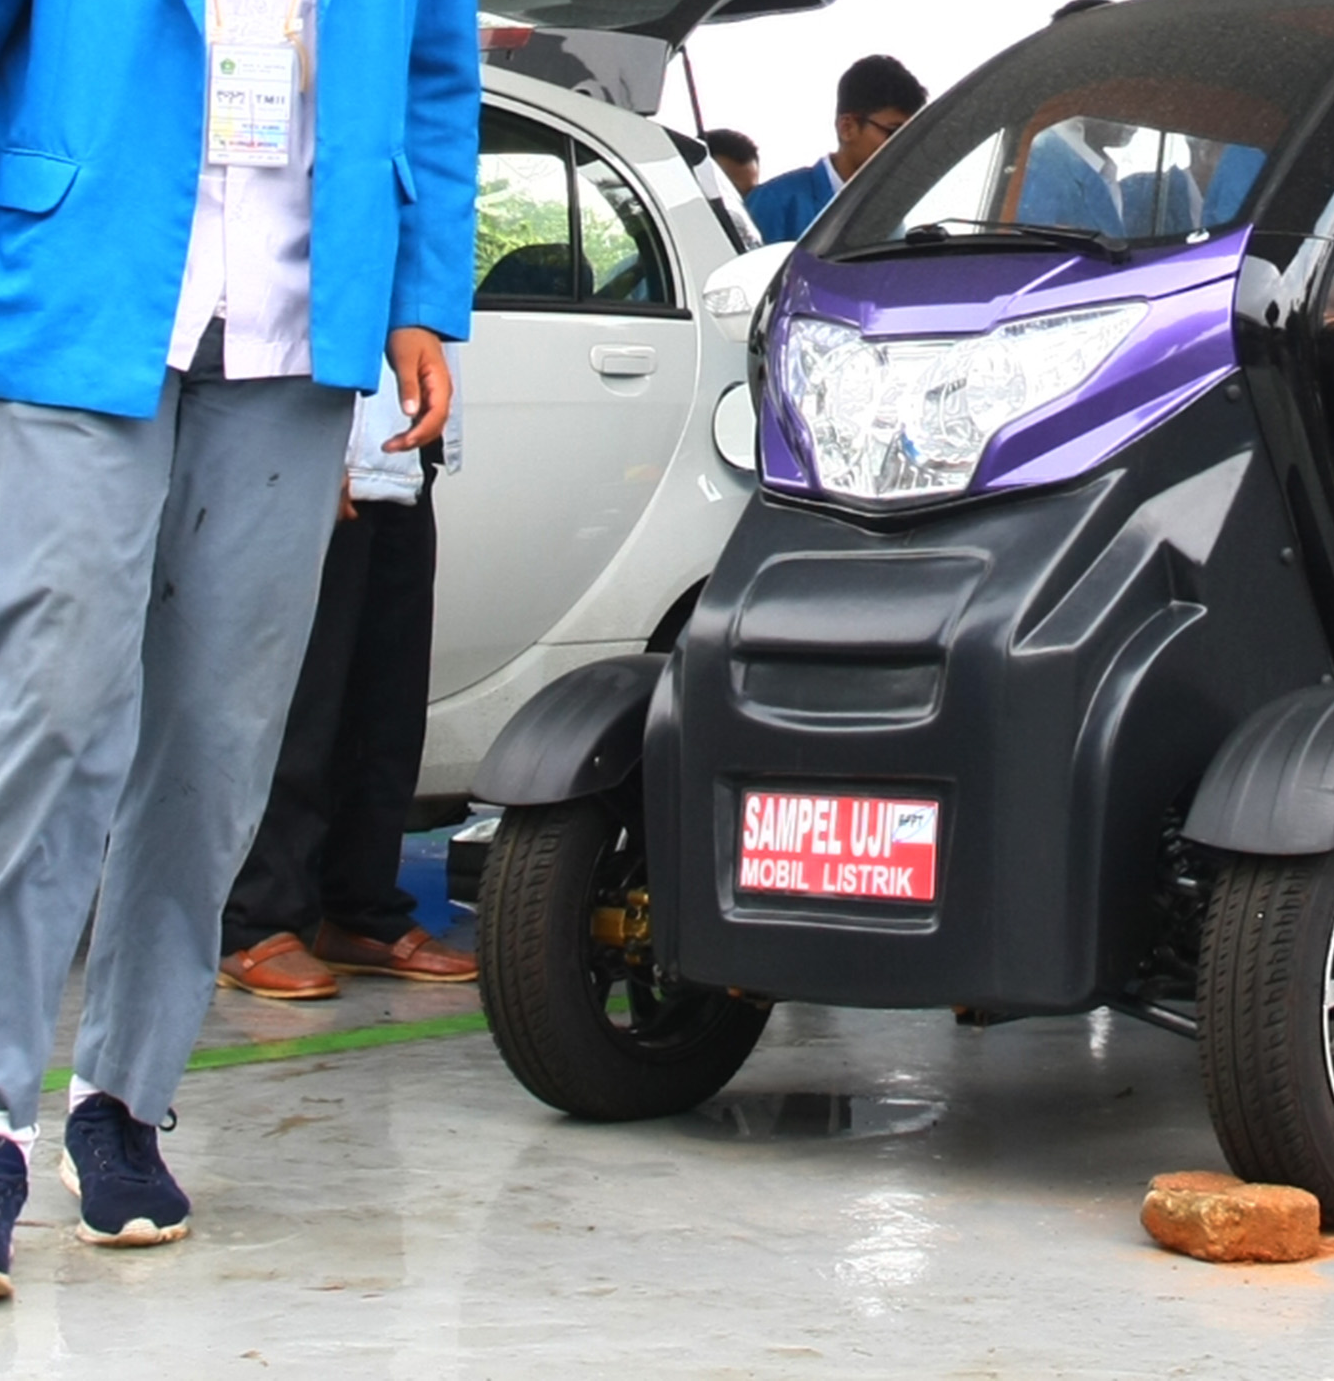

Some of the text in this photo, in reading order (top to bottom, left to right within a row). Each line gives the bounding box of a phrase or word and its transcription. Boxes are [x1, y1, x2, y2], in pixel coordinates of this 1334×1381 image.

[743, 795, 893, 858] SAMPEL UJI
[740, 857, 914, 897] MOBIL LISTRIK
